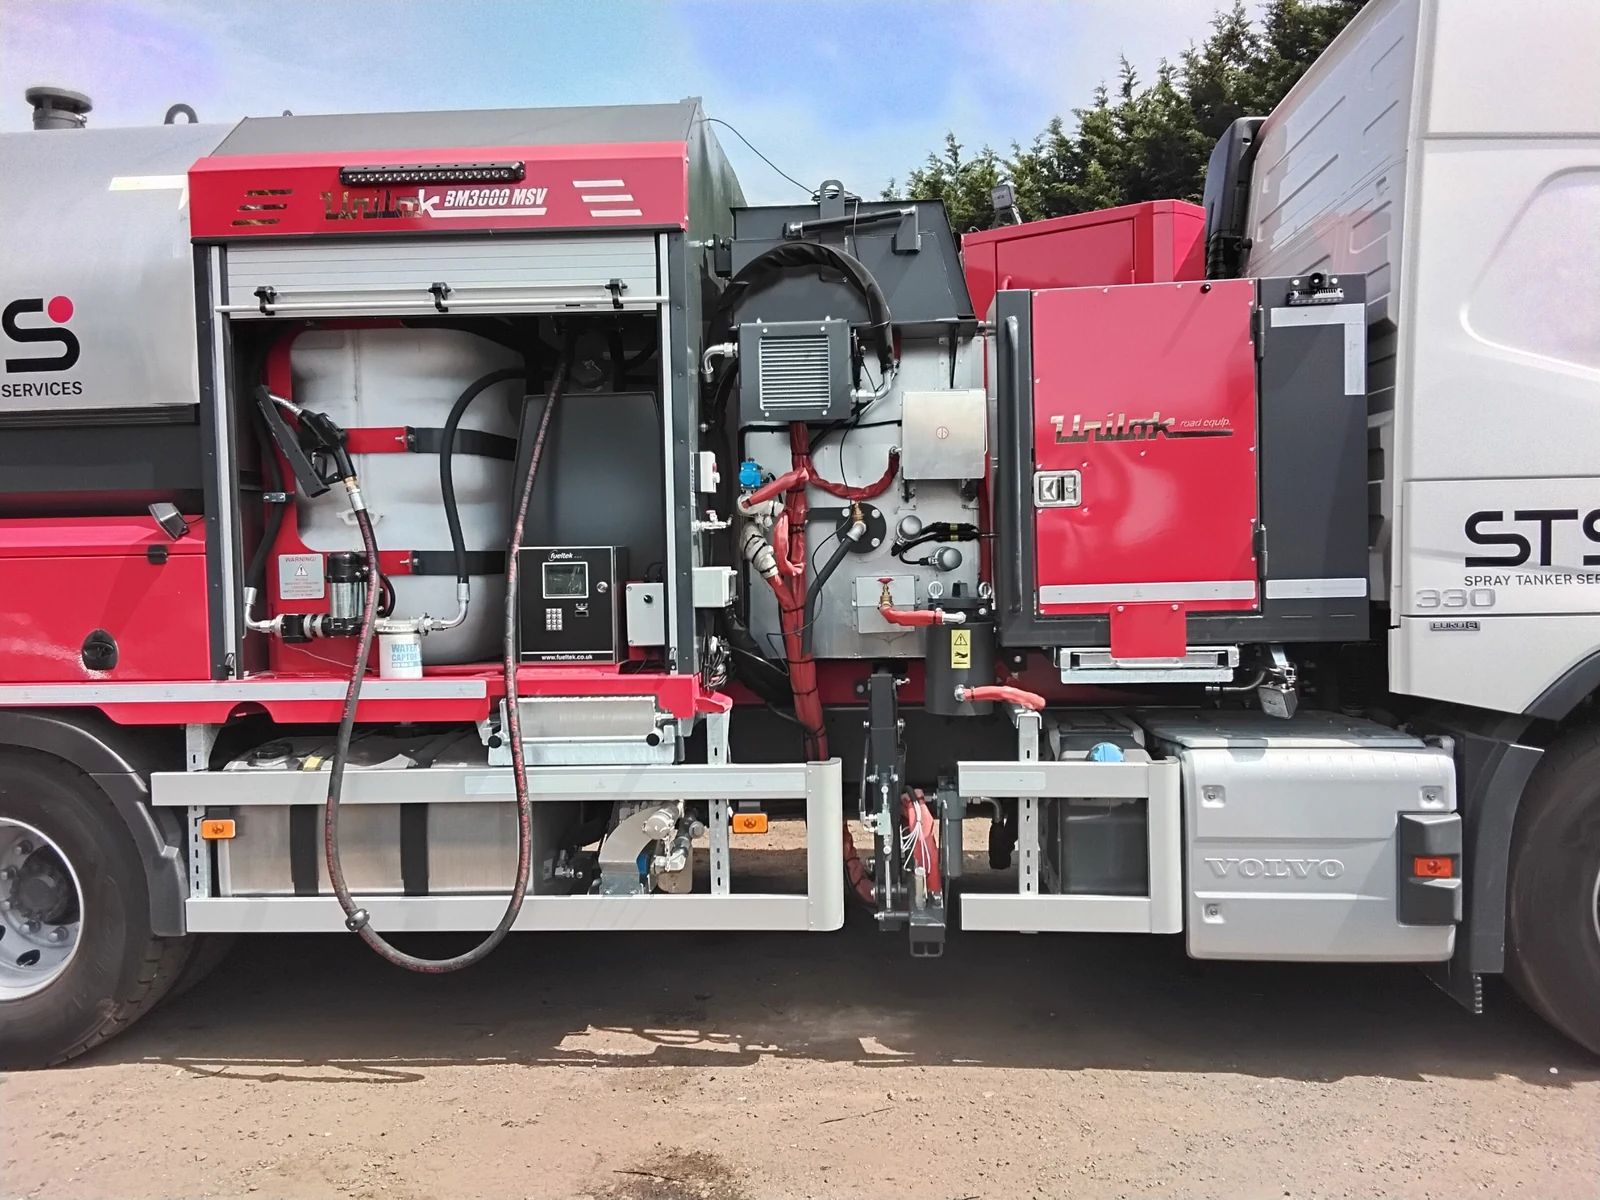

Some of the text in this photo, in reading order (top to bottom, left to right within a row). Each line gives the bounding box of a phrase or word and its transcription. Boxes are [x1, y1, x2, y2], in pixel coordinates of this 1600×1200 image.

[444, 189, 509, 207] BM3000
[511, 188, 548, 205] MSV
[1, 381, 83, 398] SERVICES
[1180, 417, 1202, 427] road
[1203, 416, 1231, 428] equip.
[1464, 509, 1600, 567] ST
[550, 552, 573, 560] fueltek
[1464, 575, 1511, 586] SPRAY
[1516, 574, 1573, 585] TANKER
[1415, 588, 1497, 609] 330
[391, 643, 417, 653] WATER
[1204, 858, 1345, 879] VOLVO
